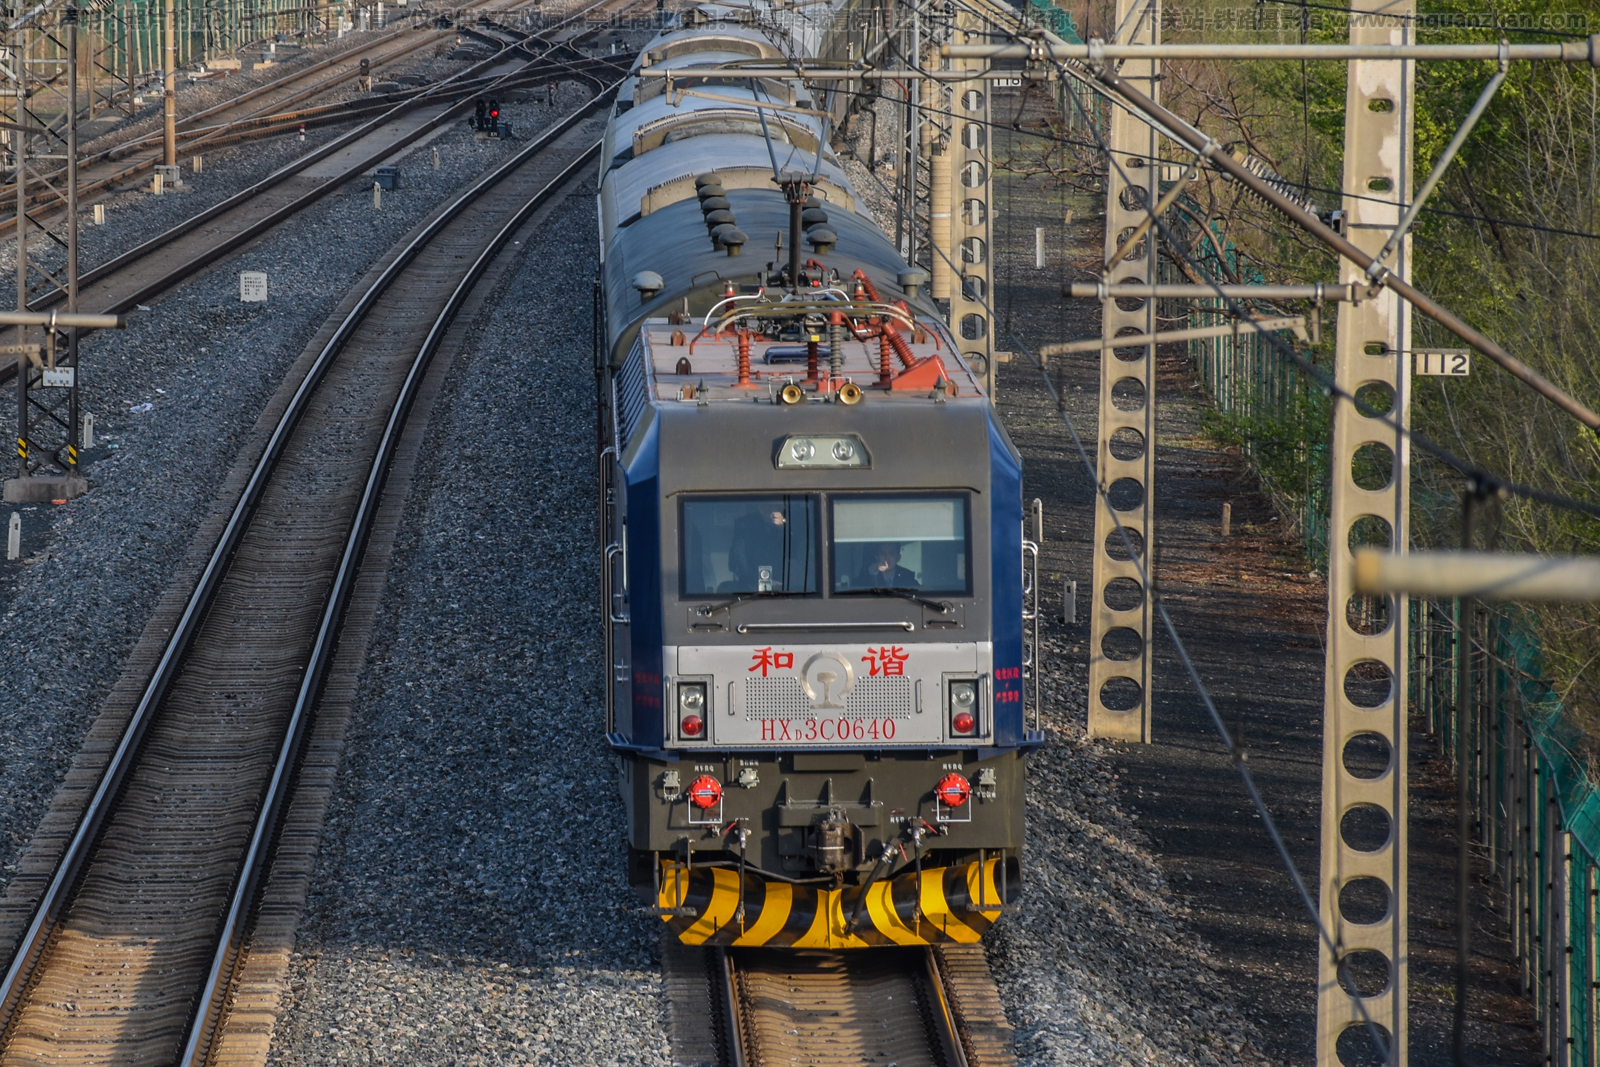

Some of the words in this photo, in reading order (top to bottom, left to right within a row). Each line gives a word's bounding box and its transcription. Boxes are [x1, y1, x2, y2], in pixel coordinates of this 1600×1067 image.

[1424, 353, 1467, 374] 112
[748, 646, 794, 677] 和
[861, 645, 910, 677] 谐
[761, 718, 896, 741] HXD3C0640
